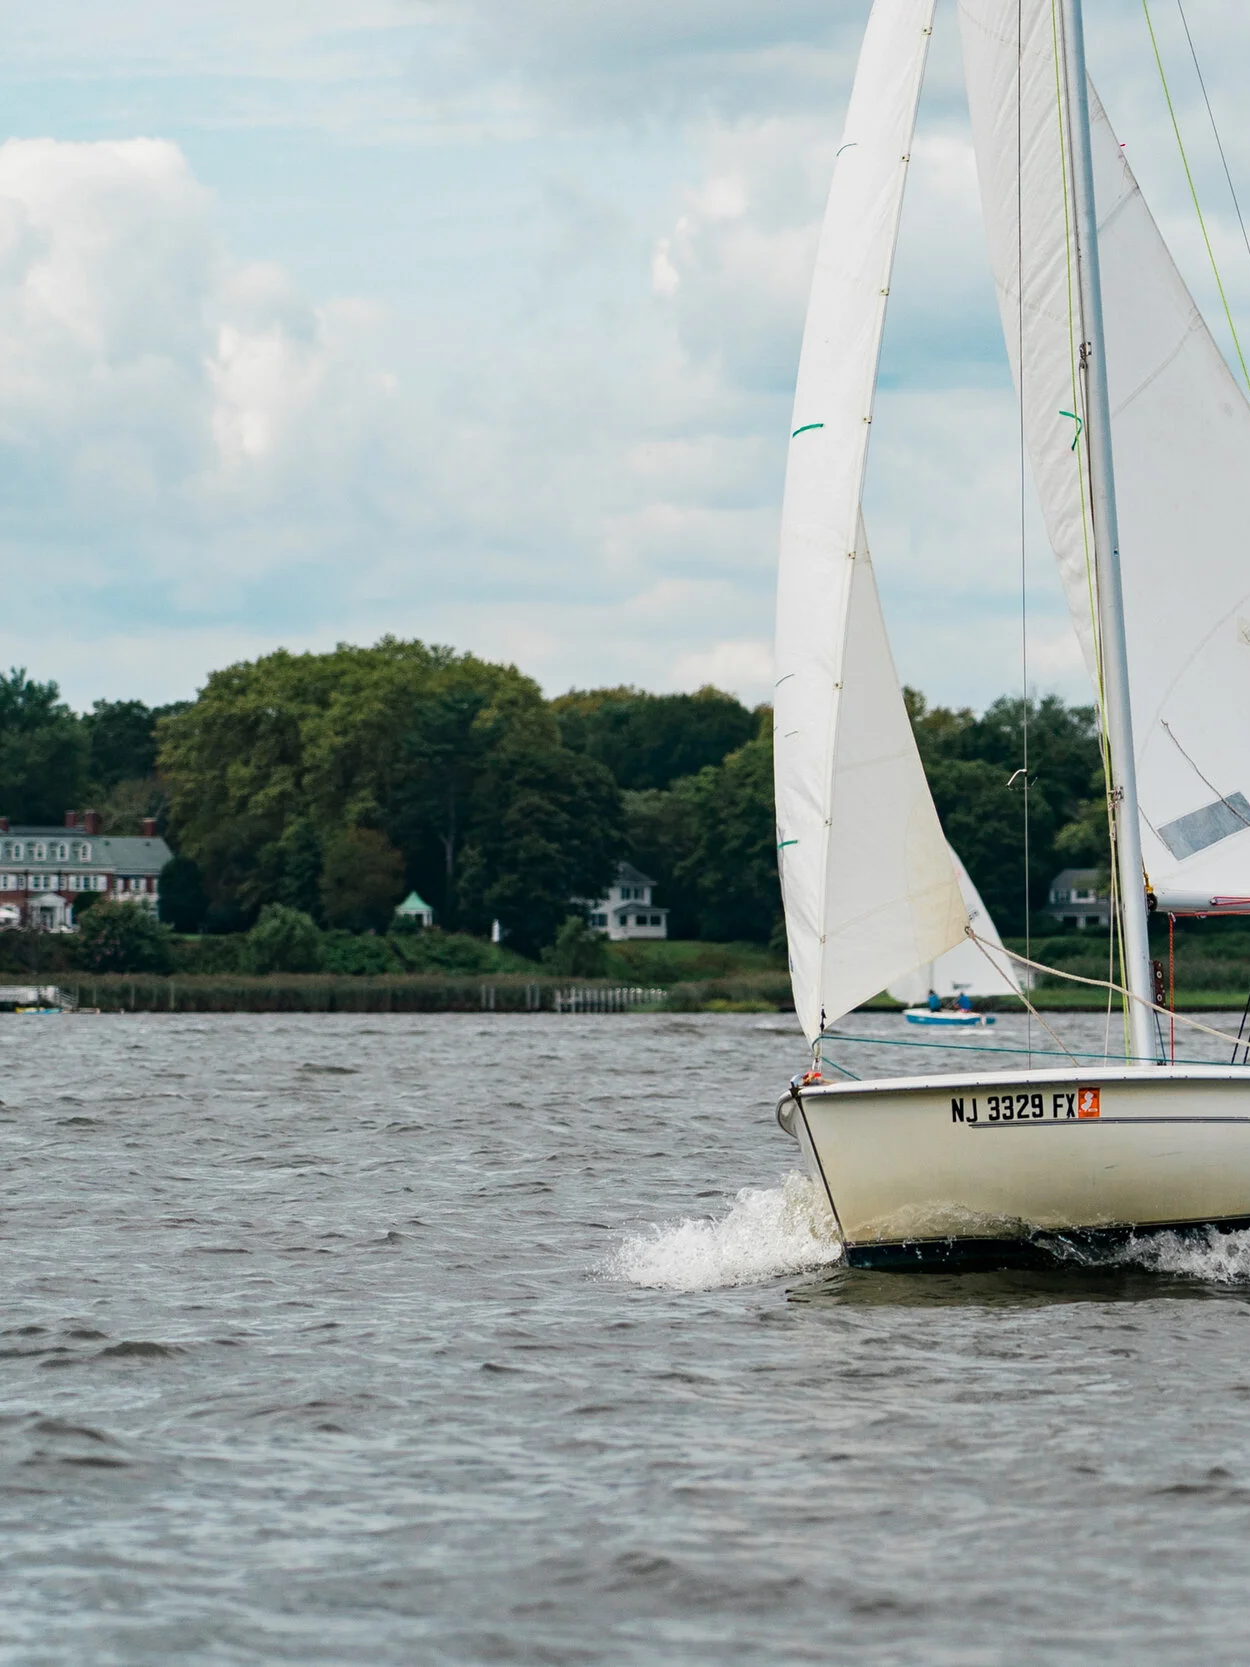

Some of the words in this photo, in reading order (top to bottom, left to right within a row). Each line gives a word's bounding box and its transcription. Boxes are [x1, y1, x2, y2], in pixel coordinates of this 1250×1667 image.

[951, 1098, 978, 1123] NJ
[987, 1094, 1044, 1121] 3329
[1053, 1093, 1076, 1119] FX
